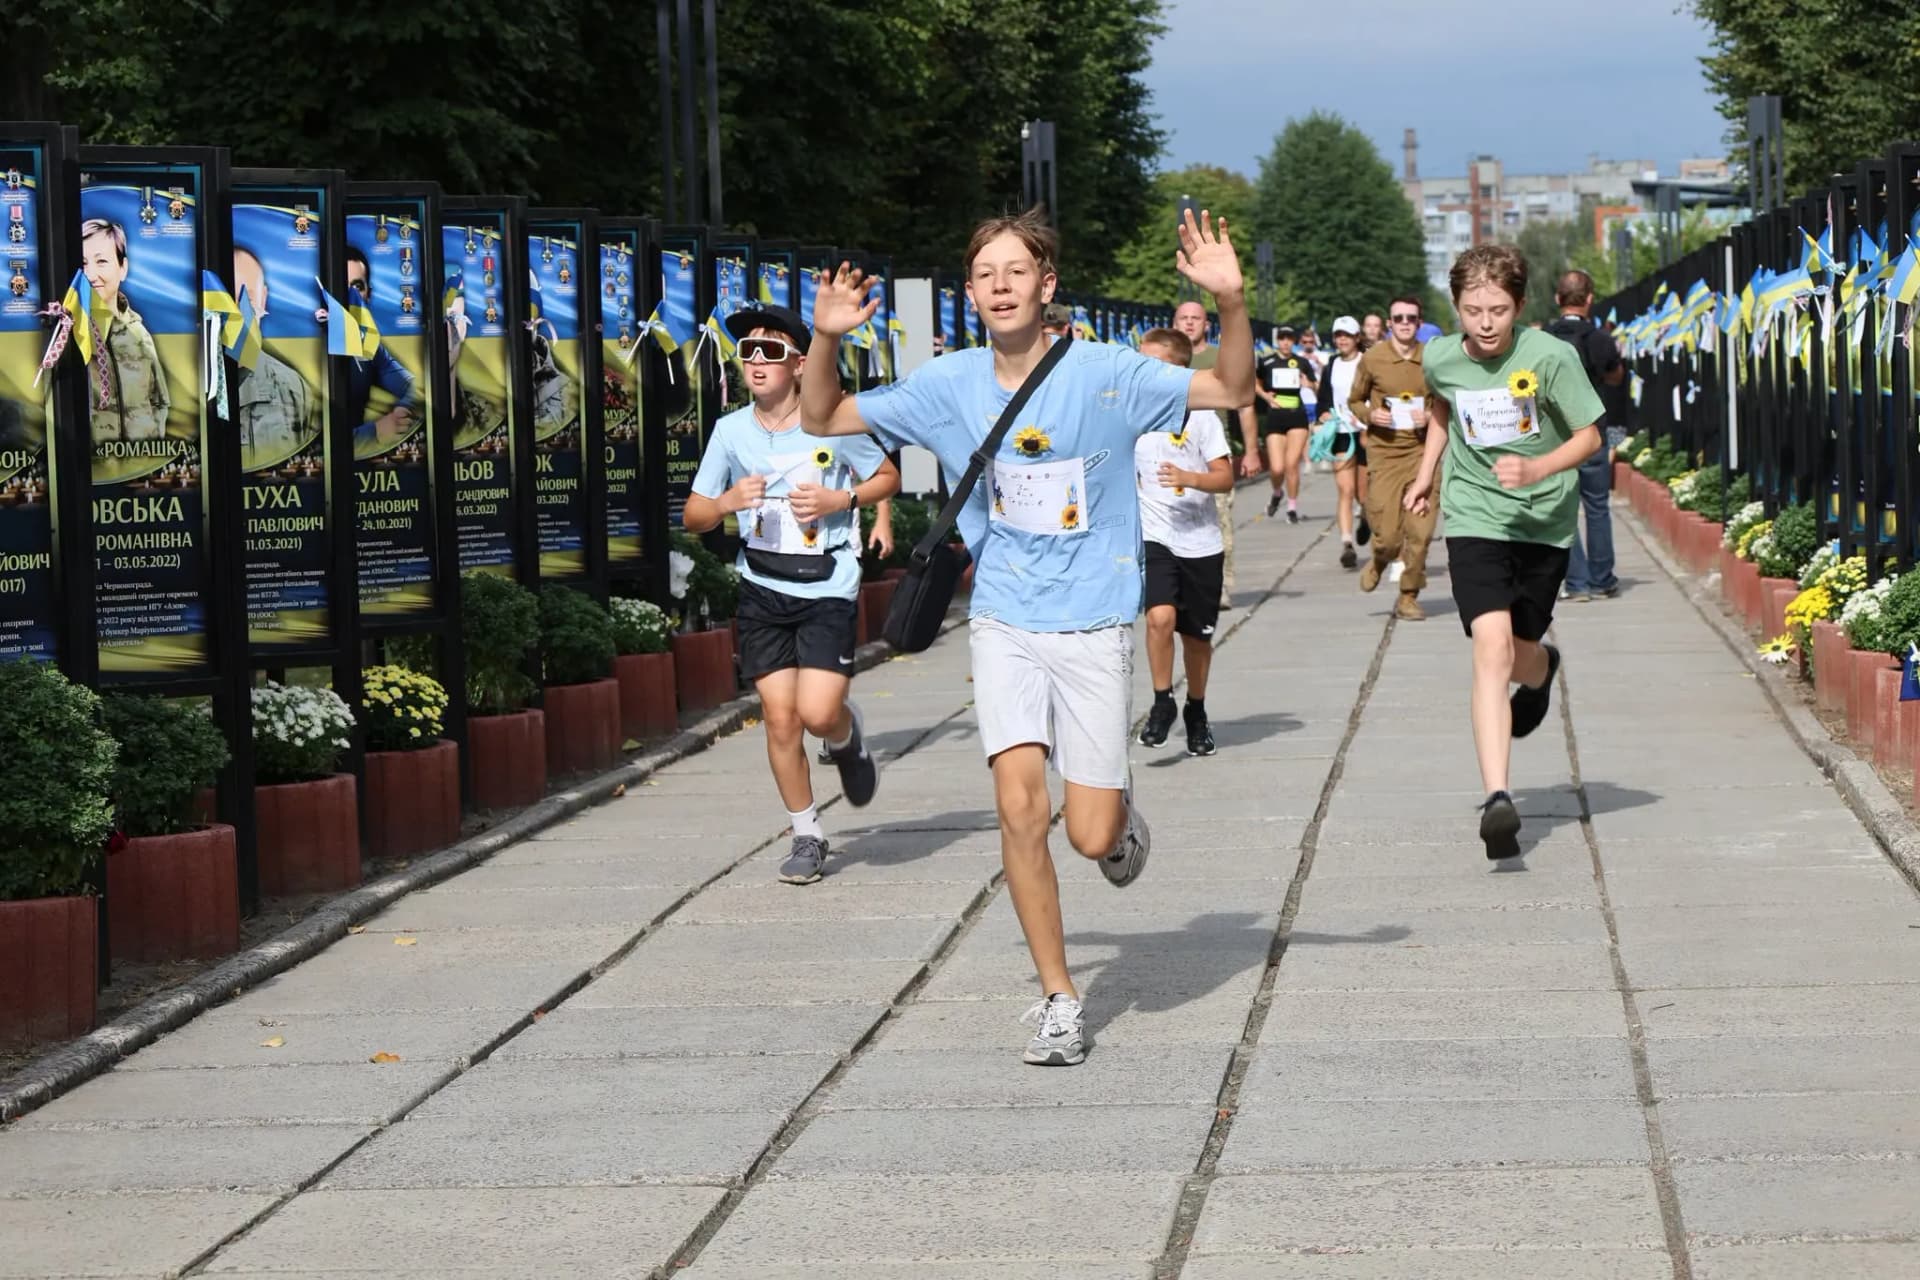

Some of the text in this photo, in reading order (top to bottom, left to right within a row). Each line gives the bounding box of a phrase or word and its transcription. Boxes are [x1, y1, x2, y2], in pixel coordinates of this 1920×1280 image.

[96, 440, 197, 458] «РОМАШКА»
[0, 450, 37, 469] ОН»
[354, 470, 401, 493] УЛА
[355, 498, 419, 518] ДАНОВИЧ
[248, 516, 324, 533] ПАВЛОВИЧ
[96, 532, 193, 551] РОМАНІВНА
[114, 553, 181, 570] 03.05.2022)
